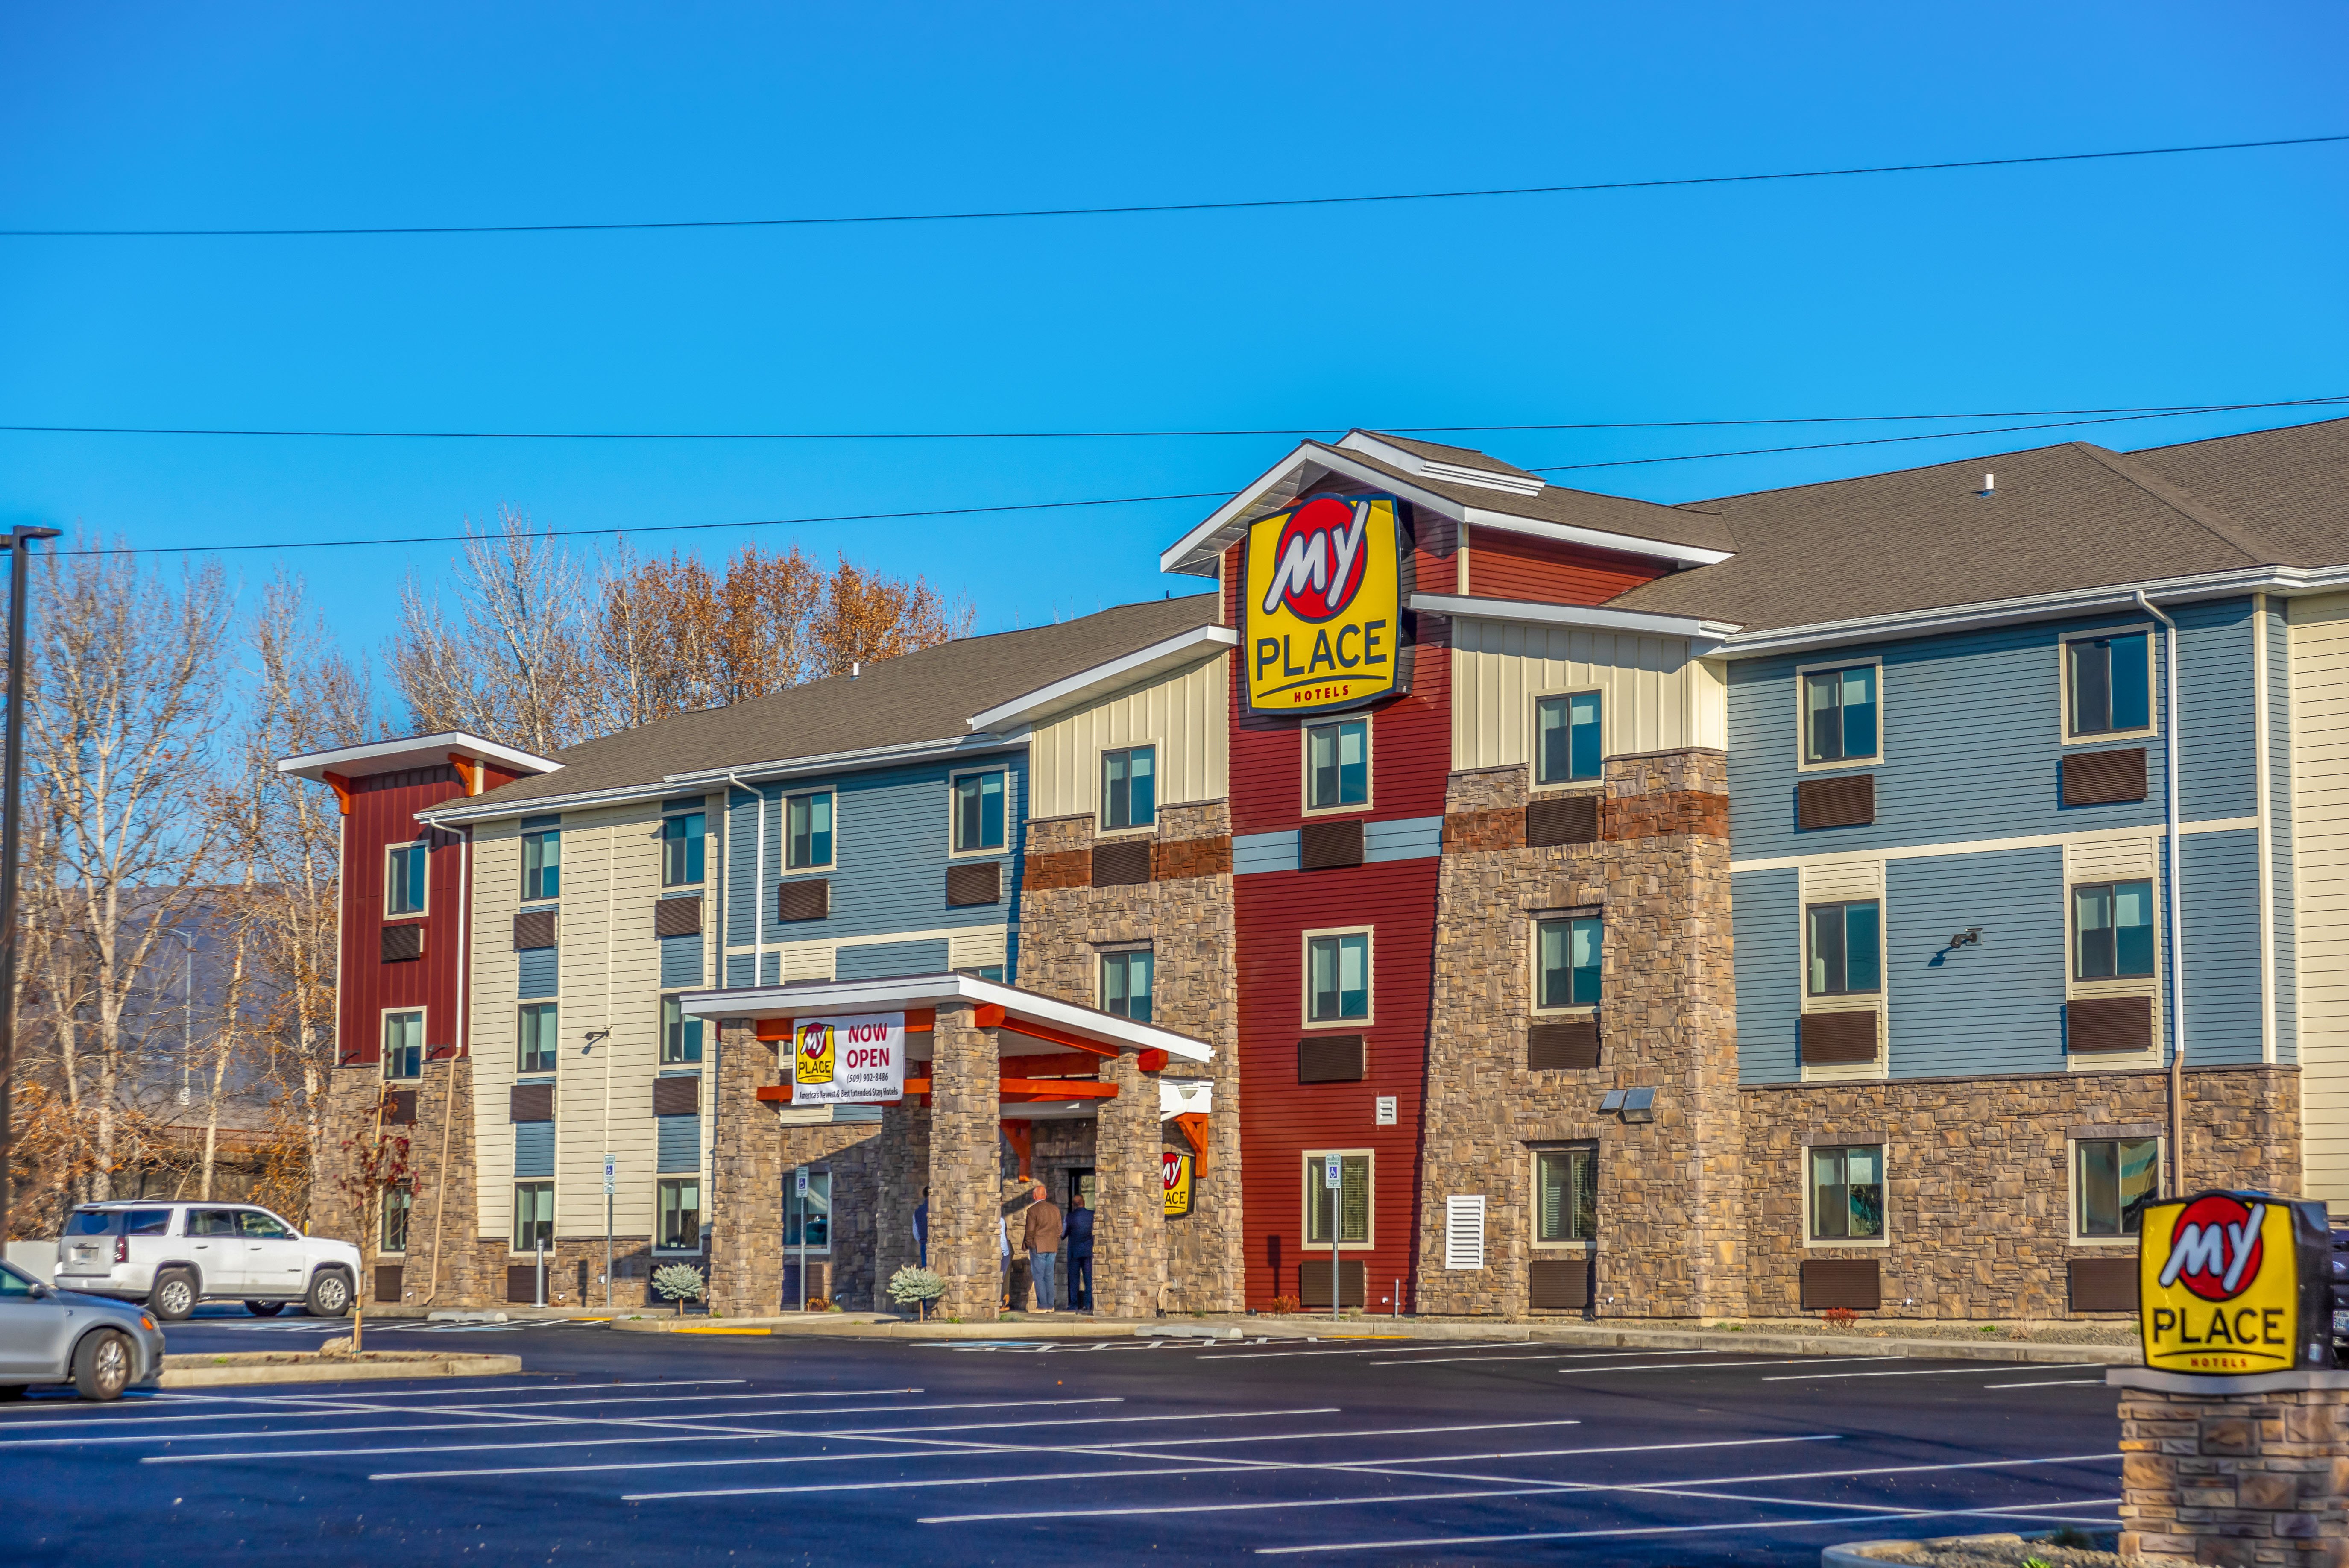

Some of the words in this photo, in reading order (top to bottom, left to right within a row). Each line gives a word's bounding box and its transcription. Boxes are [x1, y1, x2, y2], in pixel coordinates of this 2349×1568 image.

[1257, 618, 1388, 682] PLACE
[1294, 685, 1349, 703] HOTELS
[848, 1023, 887, 1043] NOW
[846, 1048, 890, 1069] OPEN
[798, 1060, 832, 1075] PLACE
[846, 1073, 862, 1084] (509)
[863, 1073, 888, 1082] 902-8486
[799, 1091, 819, 1099] America's
[836, 1090, 840, 1098] &
[850, 1088, 872, 1097] Extended
[872, 1088, 882, 1098] Stay
[883, 1087, 898, 1096] Hotels
[1165, 1191, 1186, 1205] ACE
[2152, 1307, 2285, 1345] PLACE
[2190, 1357, 2247, 1368] HOTELS
